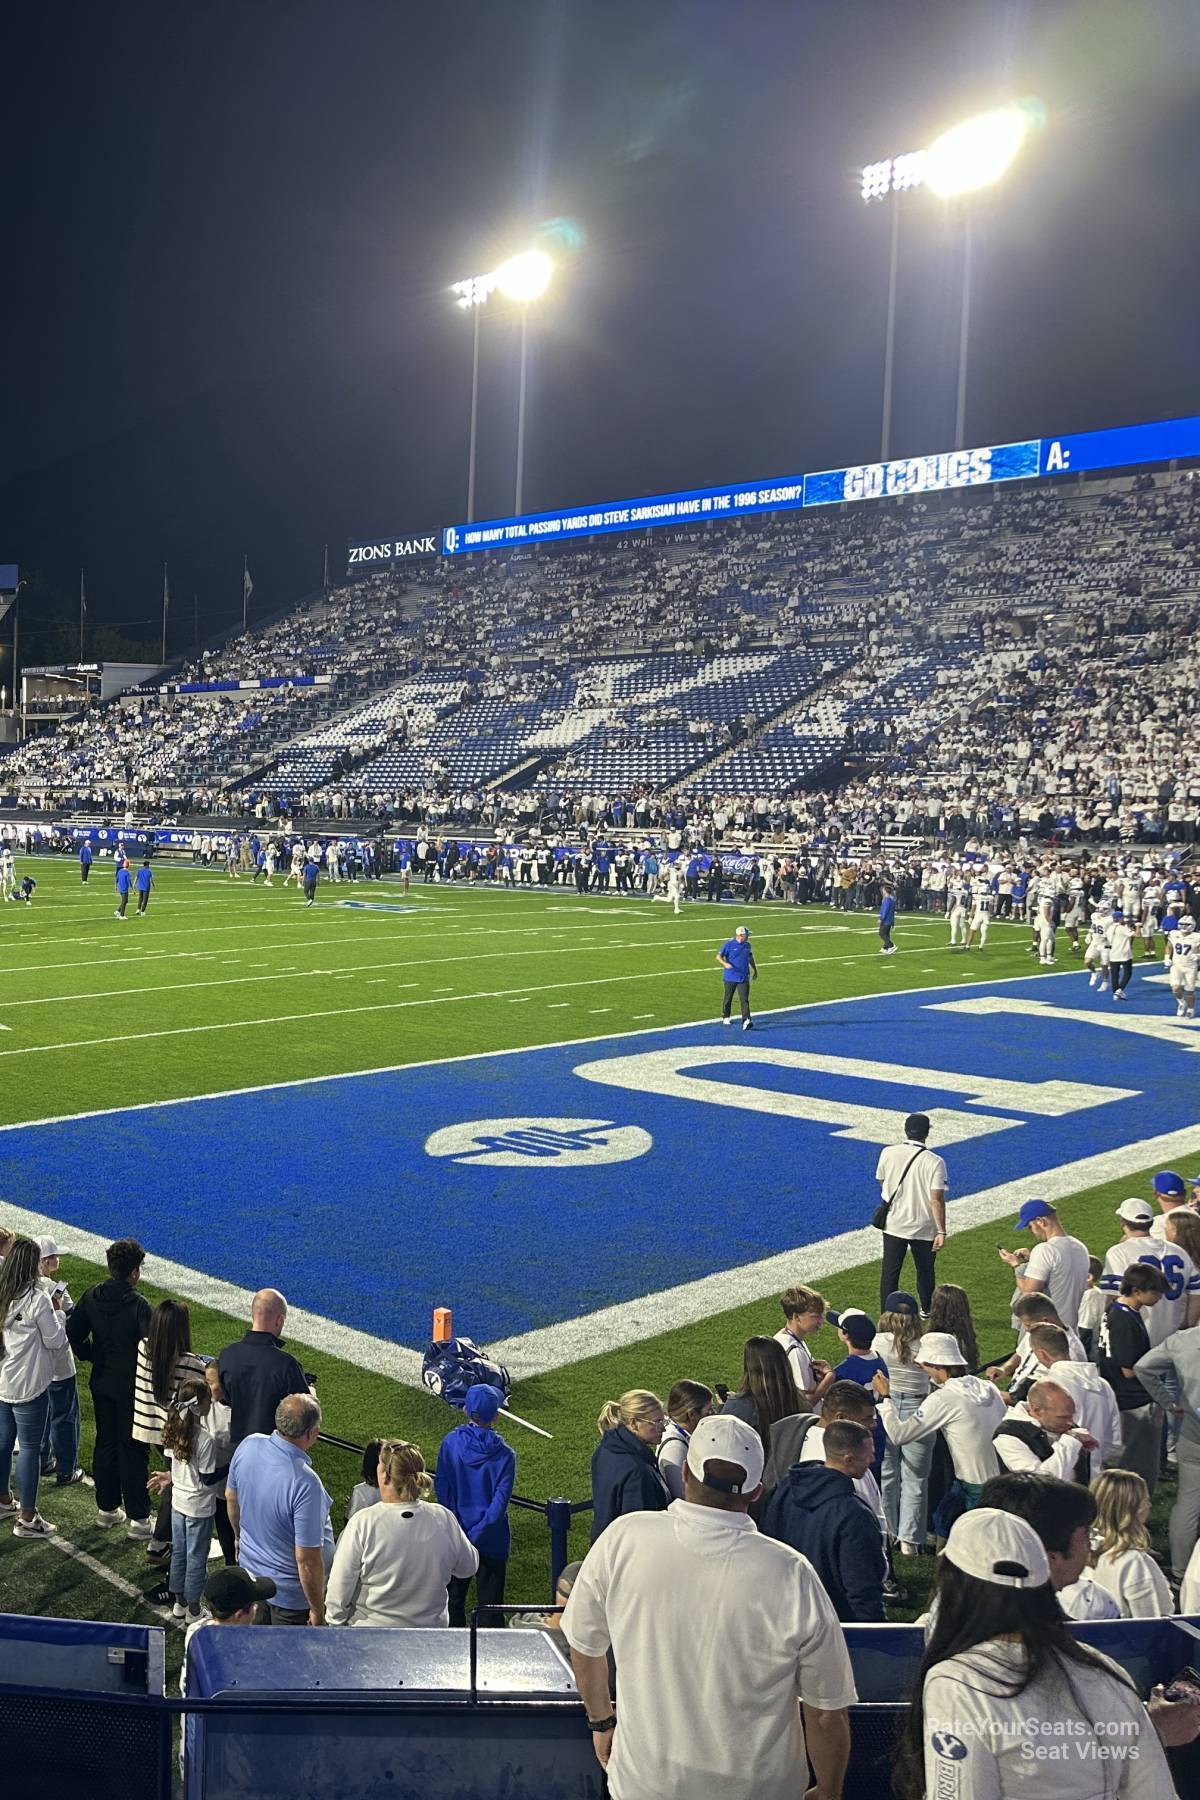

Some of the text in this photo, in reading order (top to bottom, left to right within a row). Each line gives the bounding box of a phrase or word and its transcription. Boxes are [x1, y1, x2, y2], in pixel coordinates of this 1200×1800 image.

[1046, 441, 1070, 471] A:
[843, 449, 992, 499] GO COUGS
[446, 485, 802, 553] Q: HOW MANY TOTAL PASSING YARDS DID STEVE SARKISIAN HAVE IN THE 1996 SEASON?
[349, 537, 437, 563] ZIONS BANK
[170, 834, 193, 842] BYU
